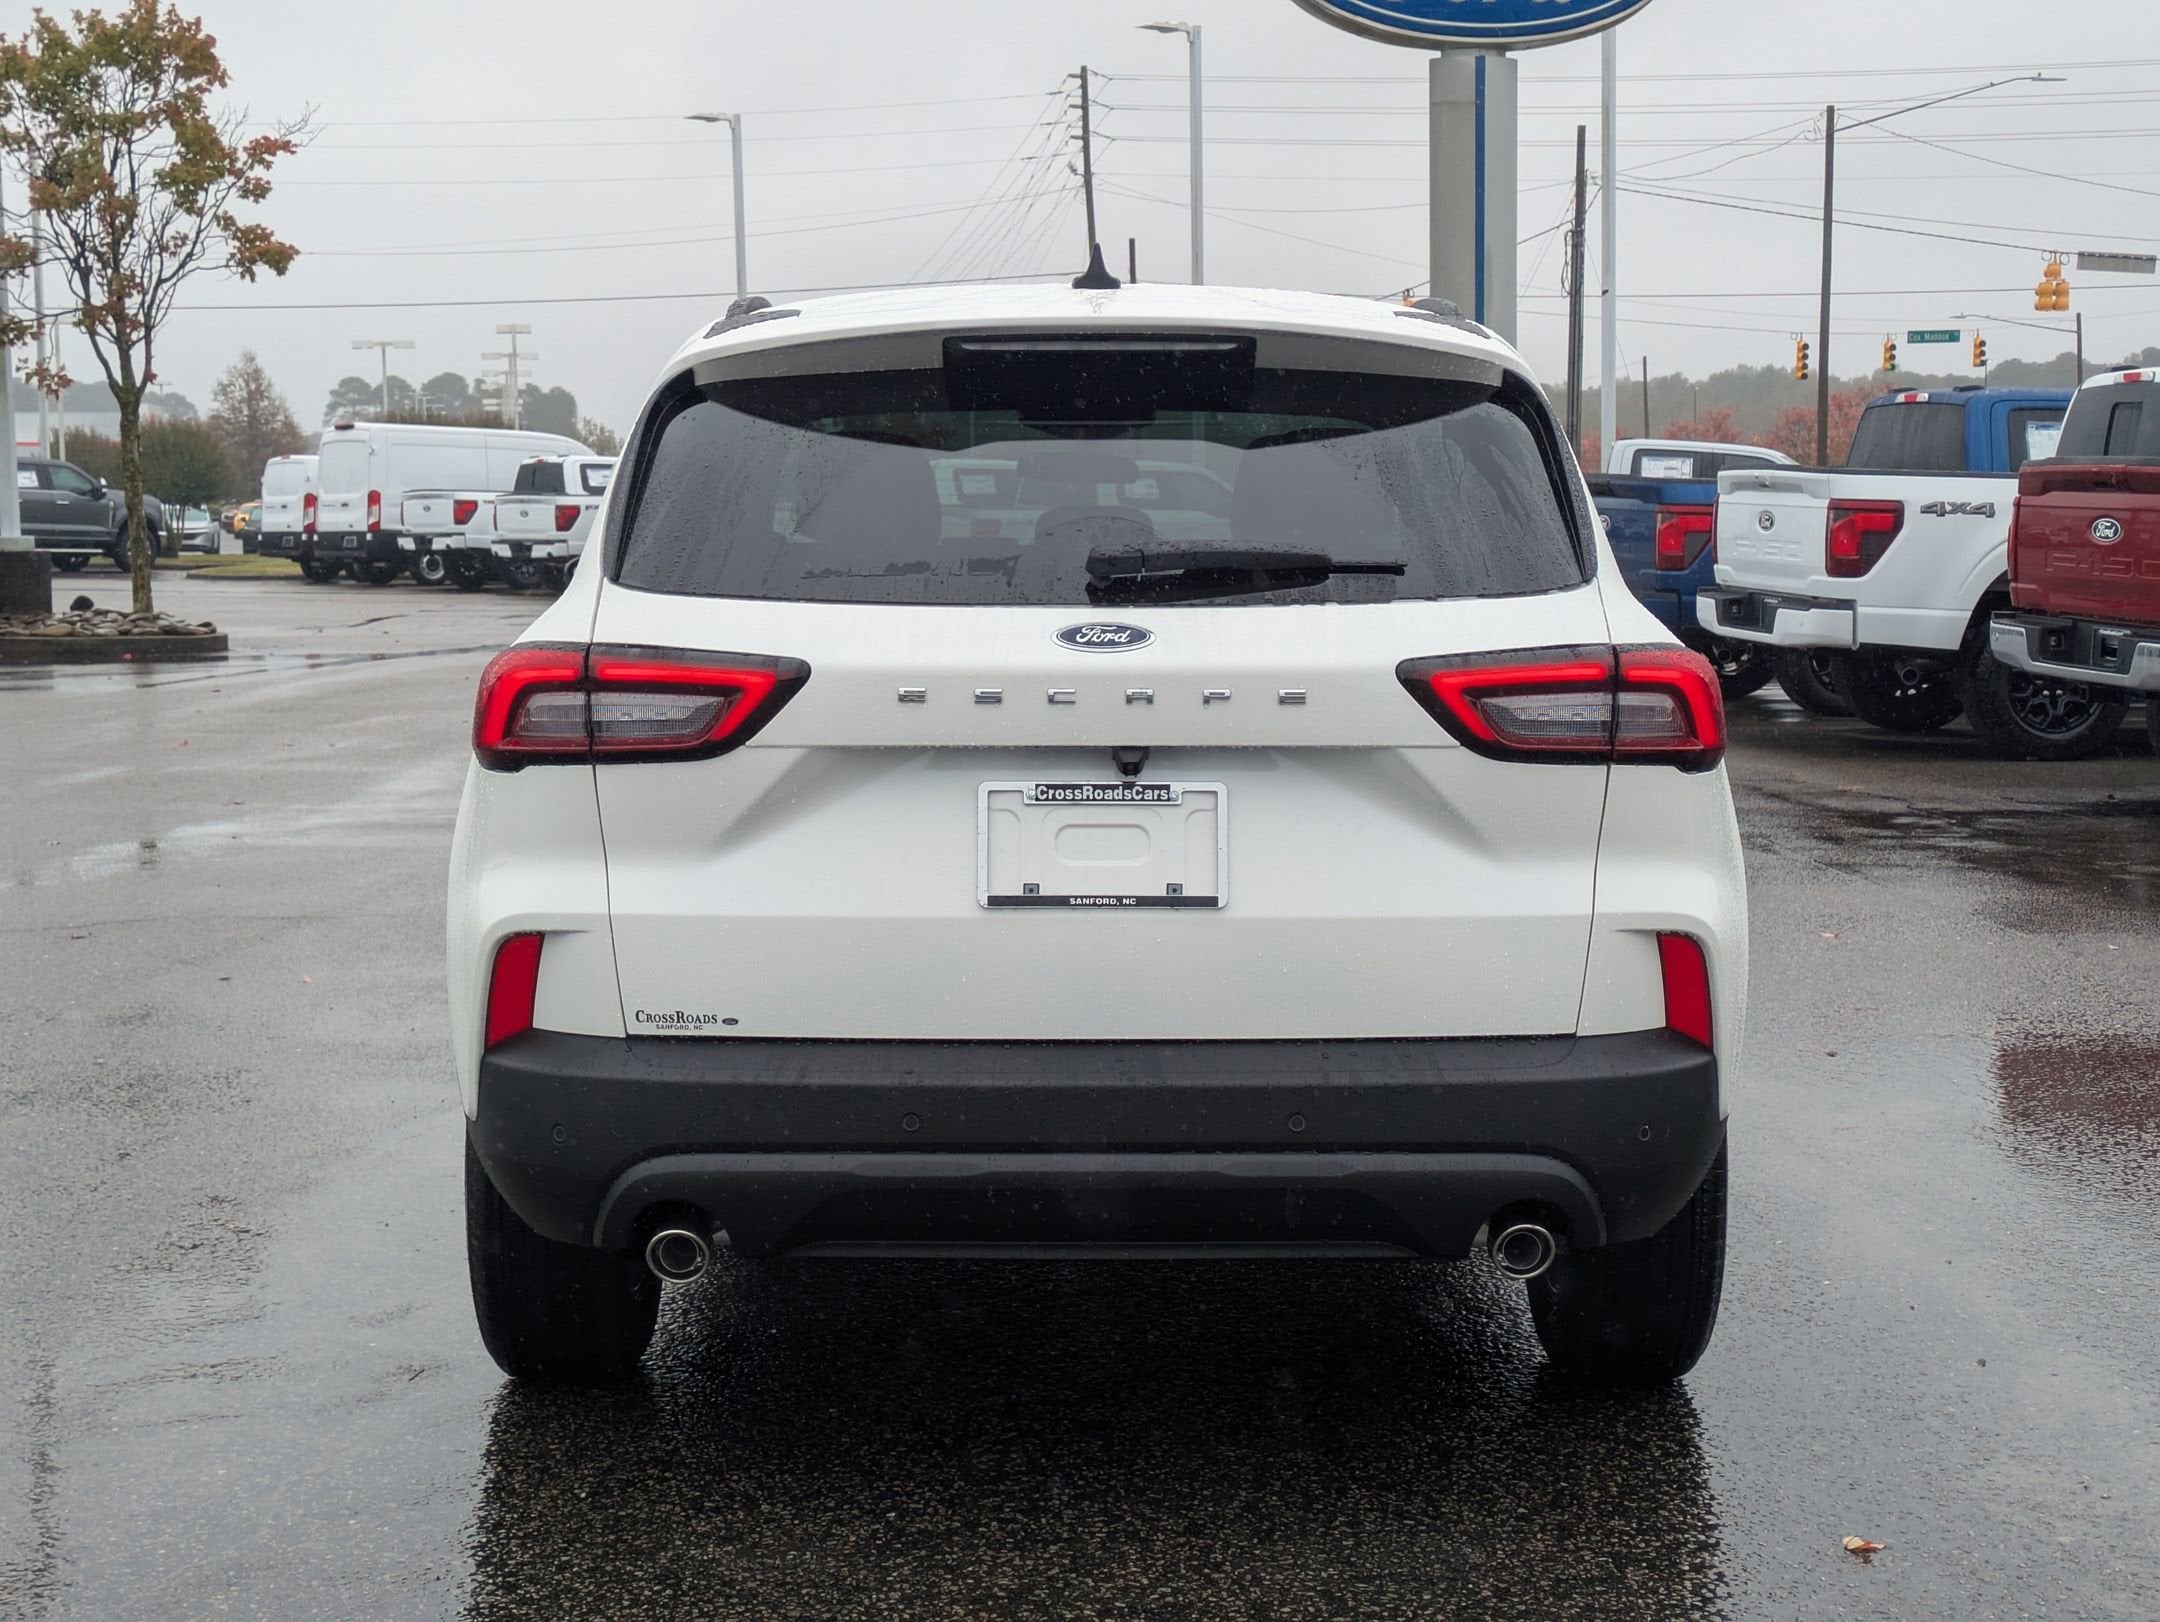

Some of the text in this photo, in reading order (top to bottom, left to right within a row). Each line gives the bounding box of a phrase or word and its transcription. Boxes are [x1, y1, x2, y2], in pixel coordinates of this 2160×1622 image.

[1075, 625, 1131, 644] Ford
[897, 687, 1307, 704] ESCAPE
[1036, 785, 1169, 801] CrossRoadsCars
[1069, 897, 1137, 907] SANFORD, NC
